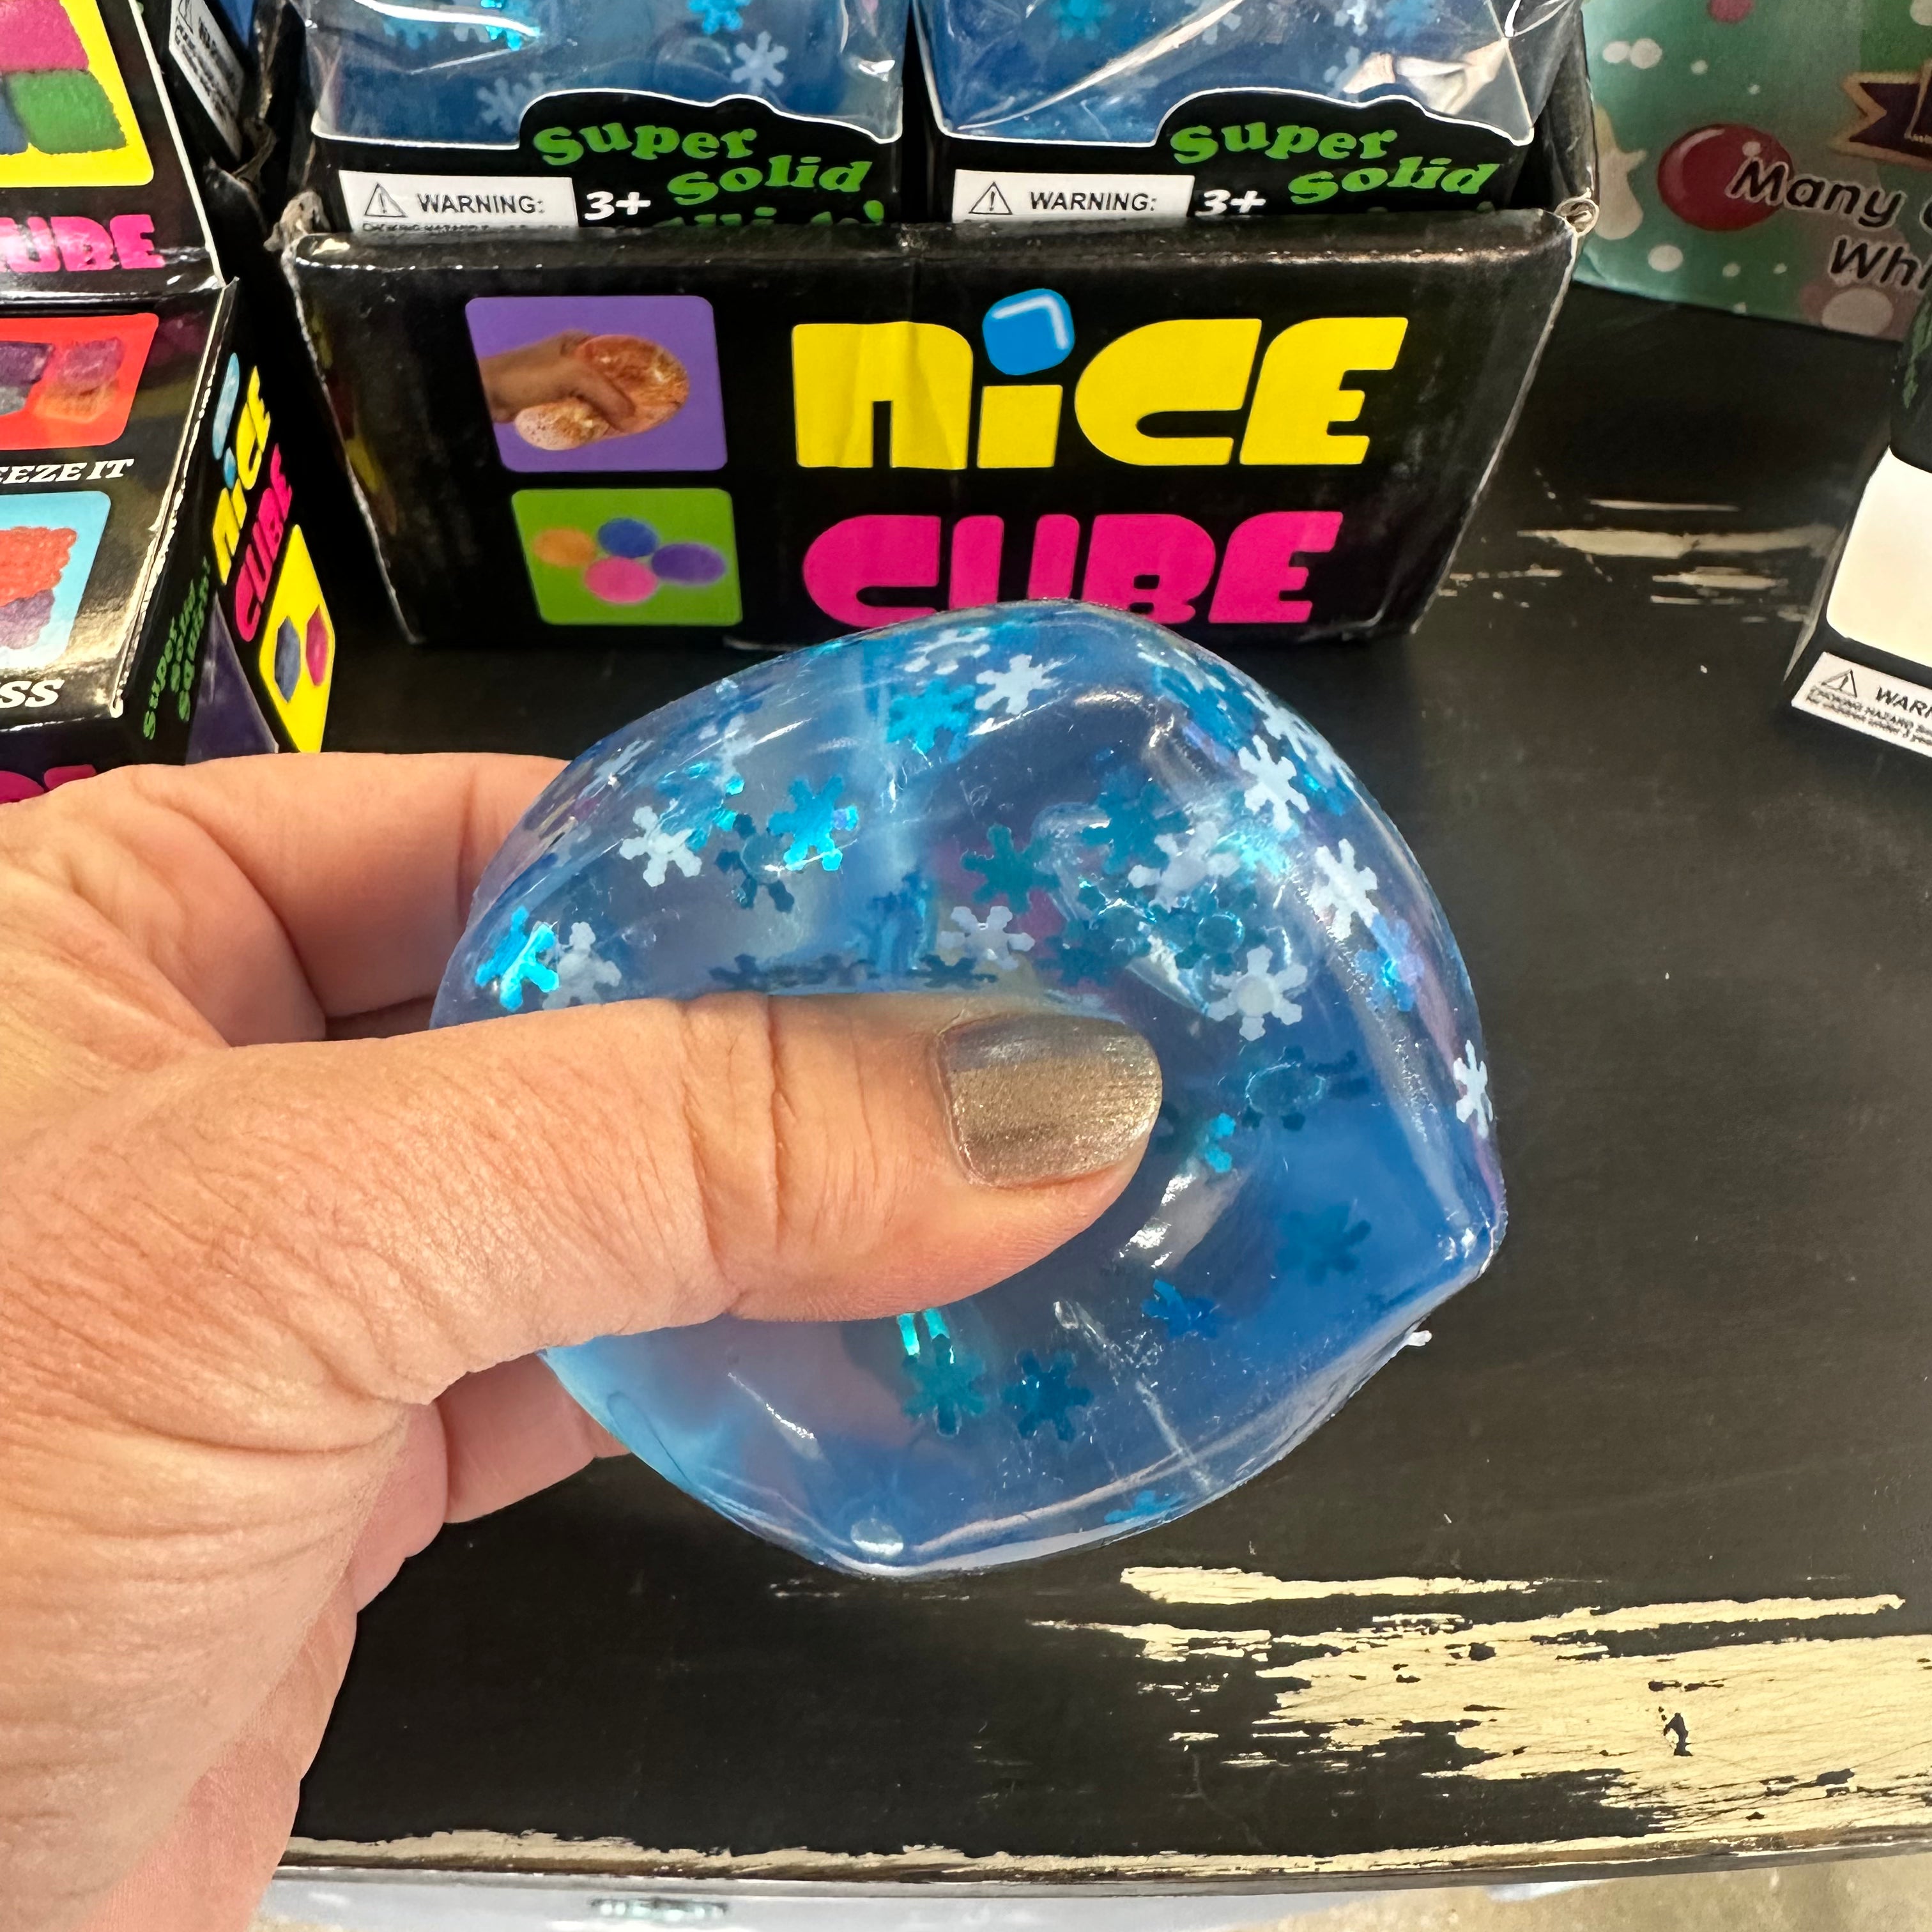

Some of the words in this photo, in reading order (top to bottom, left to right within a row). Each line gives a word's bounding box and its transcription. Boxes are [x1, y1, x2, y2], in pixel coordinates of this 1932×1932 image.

[416, 193, 546, 214] WARNING:
[584, 190, 652, 220] 3+
[1030, 191, 1158, 212] WARNING:
[1194, 190, 1267, 217] 3+
[1728, 158, 1904, 229] Many
[0, 213, 166, 273] UBE
[86, 458, 135, 480] IT
[802, 511, 1344, 624] CUBE
